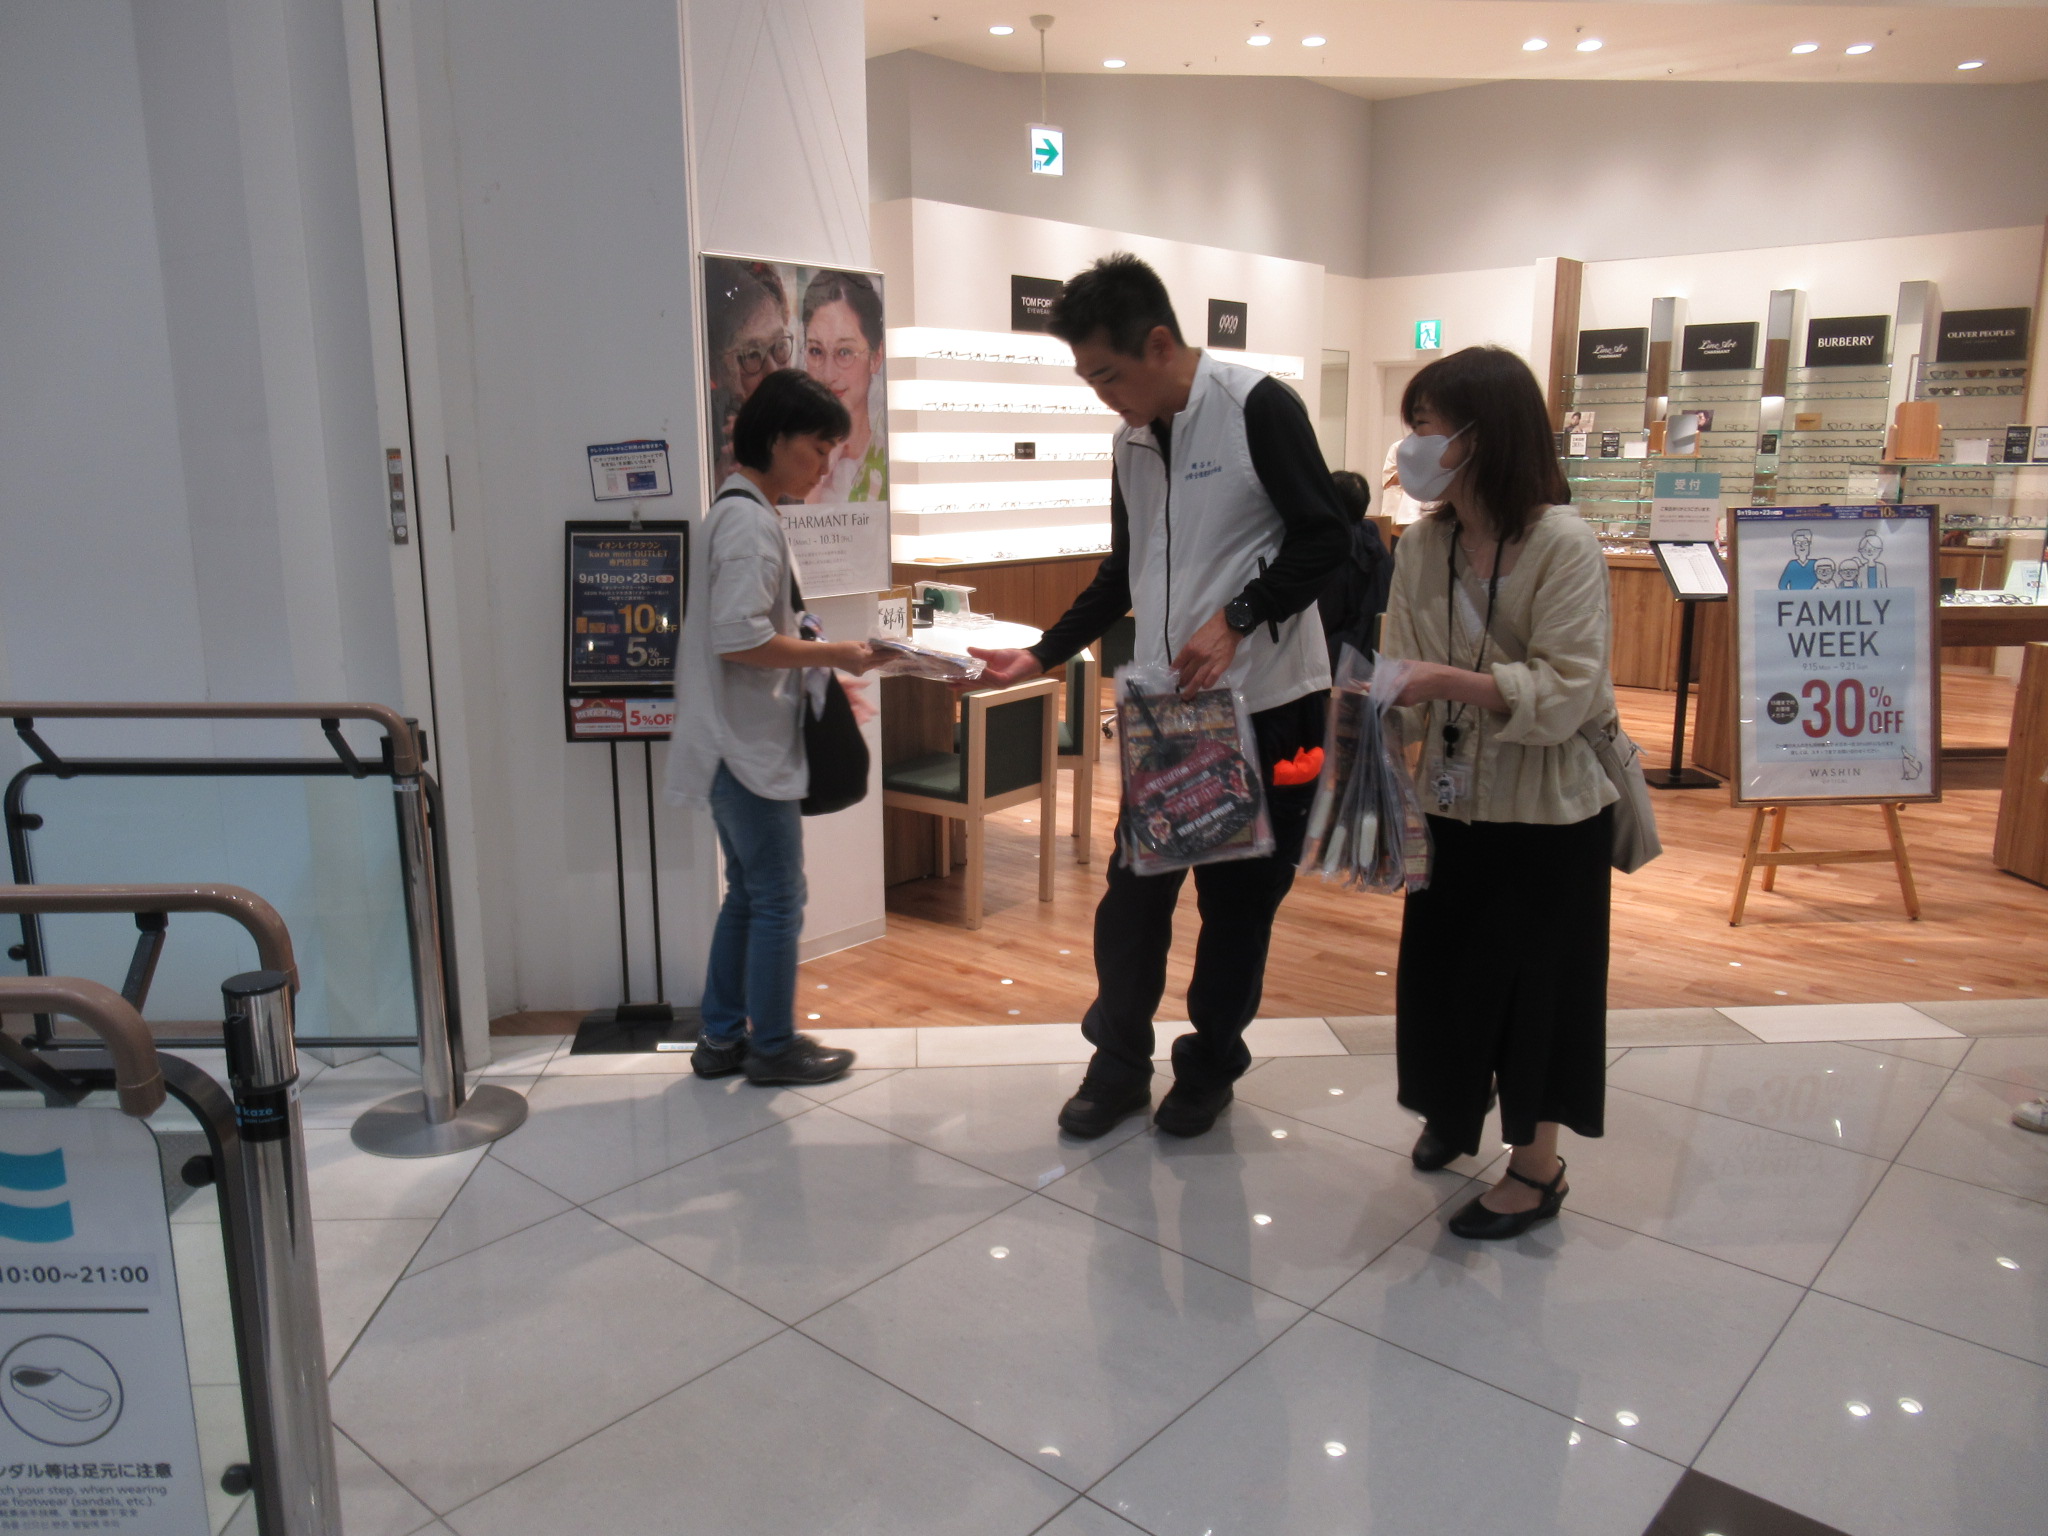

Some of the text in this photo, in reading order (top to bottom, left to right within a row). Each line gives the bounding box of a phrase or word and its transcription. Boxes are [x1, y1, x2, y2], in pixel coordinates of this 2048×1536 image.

[1021, 296, 1053, 308] TOM FOR
[1947, 329, 2016, 339] OLIVER PEOPLES
[1716, 338, 1738, 350] Art
[1817, 335, 1875, 348] BURBERRY
[1610, 343, 1628, 354] Art
[851, 513, 870, 526] Fair
[598, 541, 661, 549] イオンレイクタウン
[820, 534, 840, 545] 10.31
[618, 603, 656, 634] 10
[1777, 599, 1891, 627] FAMILY
[1787, 630, 1880, 658] WEEK
[626, 636, 648, 667] 5
[648, 658, 670, 667] OFF
[1869, 686, 1892, 708] %
[1802, 678, 1865, 738] 30
[1868, 710, 1905, 734] OFF
[1810, 768, 1861, 777] WASHIN
[18, 1487, 44, 1497] your
[80, 1485, 114, 1495] when
[117, 1485, 168, 1497] wearing
[13, 1497, 68, 1506] footwear
